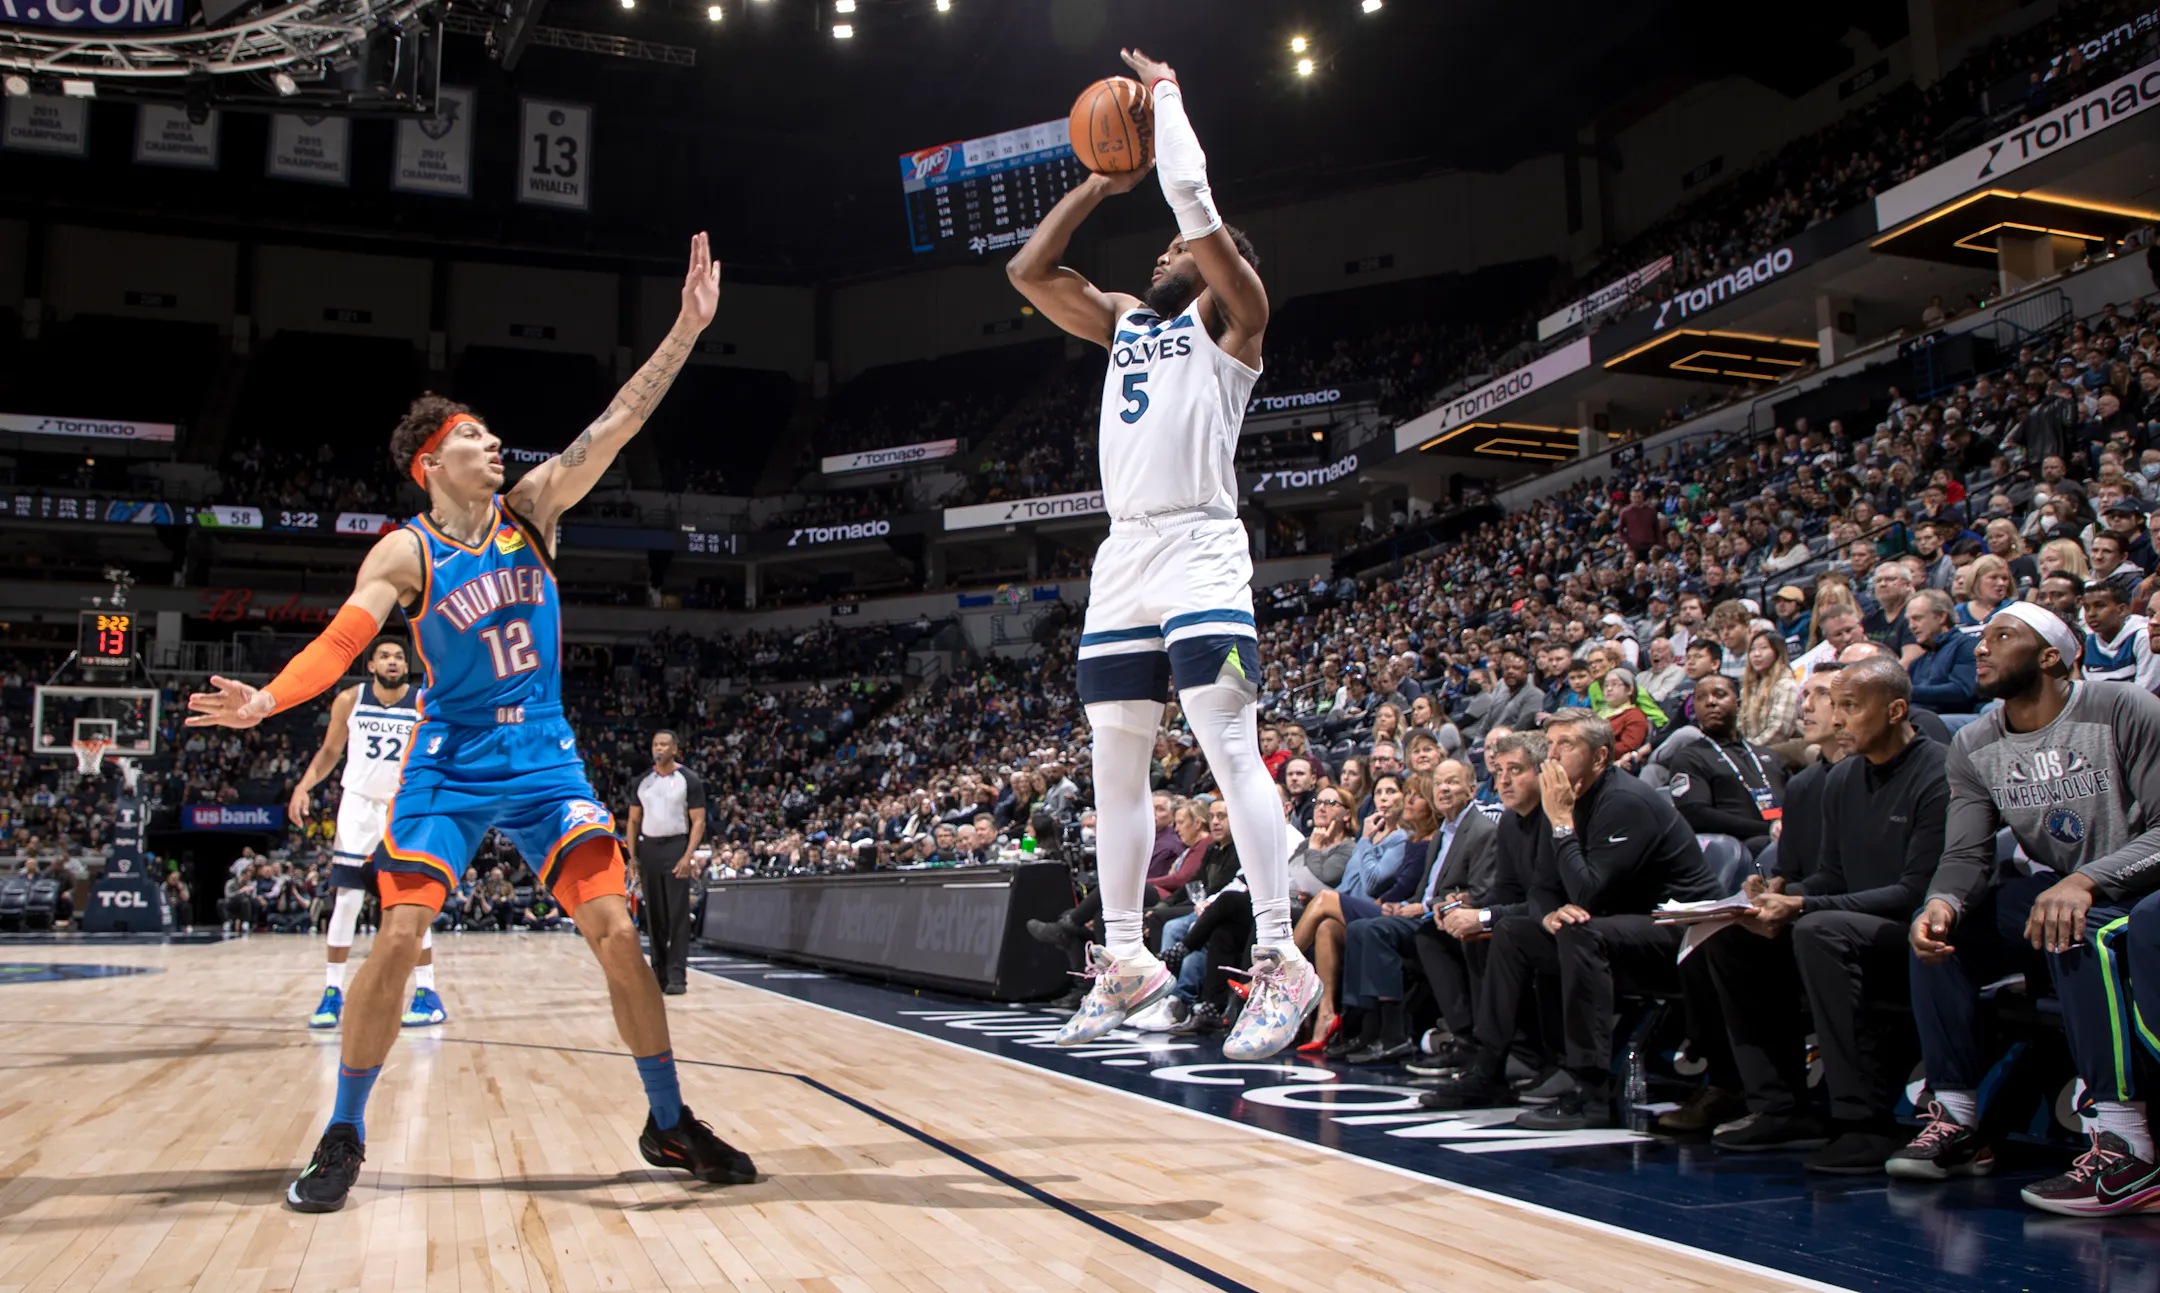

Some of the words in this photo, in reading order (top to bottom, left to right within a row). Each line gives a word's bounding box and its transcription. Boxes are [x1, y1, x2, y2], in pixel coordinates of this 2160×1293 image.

[2, 0, 173, 24] .COM
[10, 127, 77, 145] CHAMPIONS
[532, 133, 580, 178] 13
[529, 177, 580, 196] WHALEN
[1674, 247, 1794, 319] Tornado
[1113, 335, 1191, 371] OLVES
[1119, 372, 1149, 424] 5
[1264, 389, 1340, 410] Tornado
[1455, 371, 1532, 418] Tornado
[55, 420, 135, 437] Tornado
[865, 446, 926, 465] Tornado
[1276, 454, 1358, 489] Tornado
[230, 510, 251, 525] 58
[279, 511, 318, 528] 3:22
[348, 517, 369, 531] 40
[805, 520, 890, 544] Tornado
[433, 566, 546, 633] THUNDER
[97, 615, 130, 632] 3:22
[99, 631, 124, 655] 13
[480, 618, 540, 681] 12
[495, 706, 525, 725] OKC
[357, 719, 412, 737] WOLVES
[366, 736, 401, 762] 32
[98, 891, 148, 908] TCL
